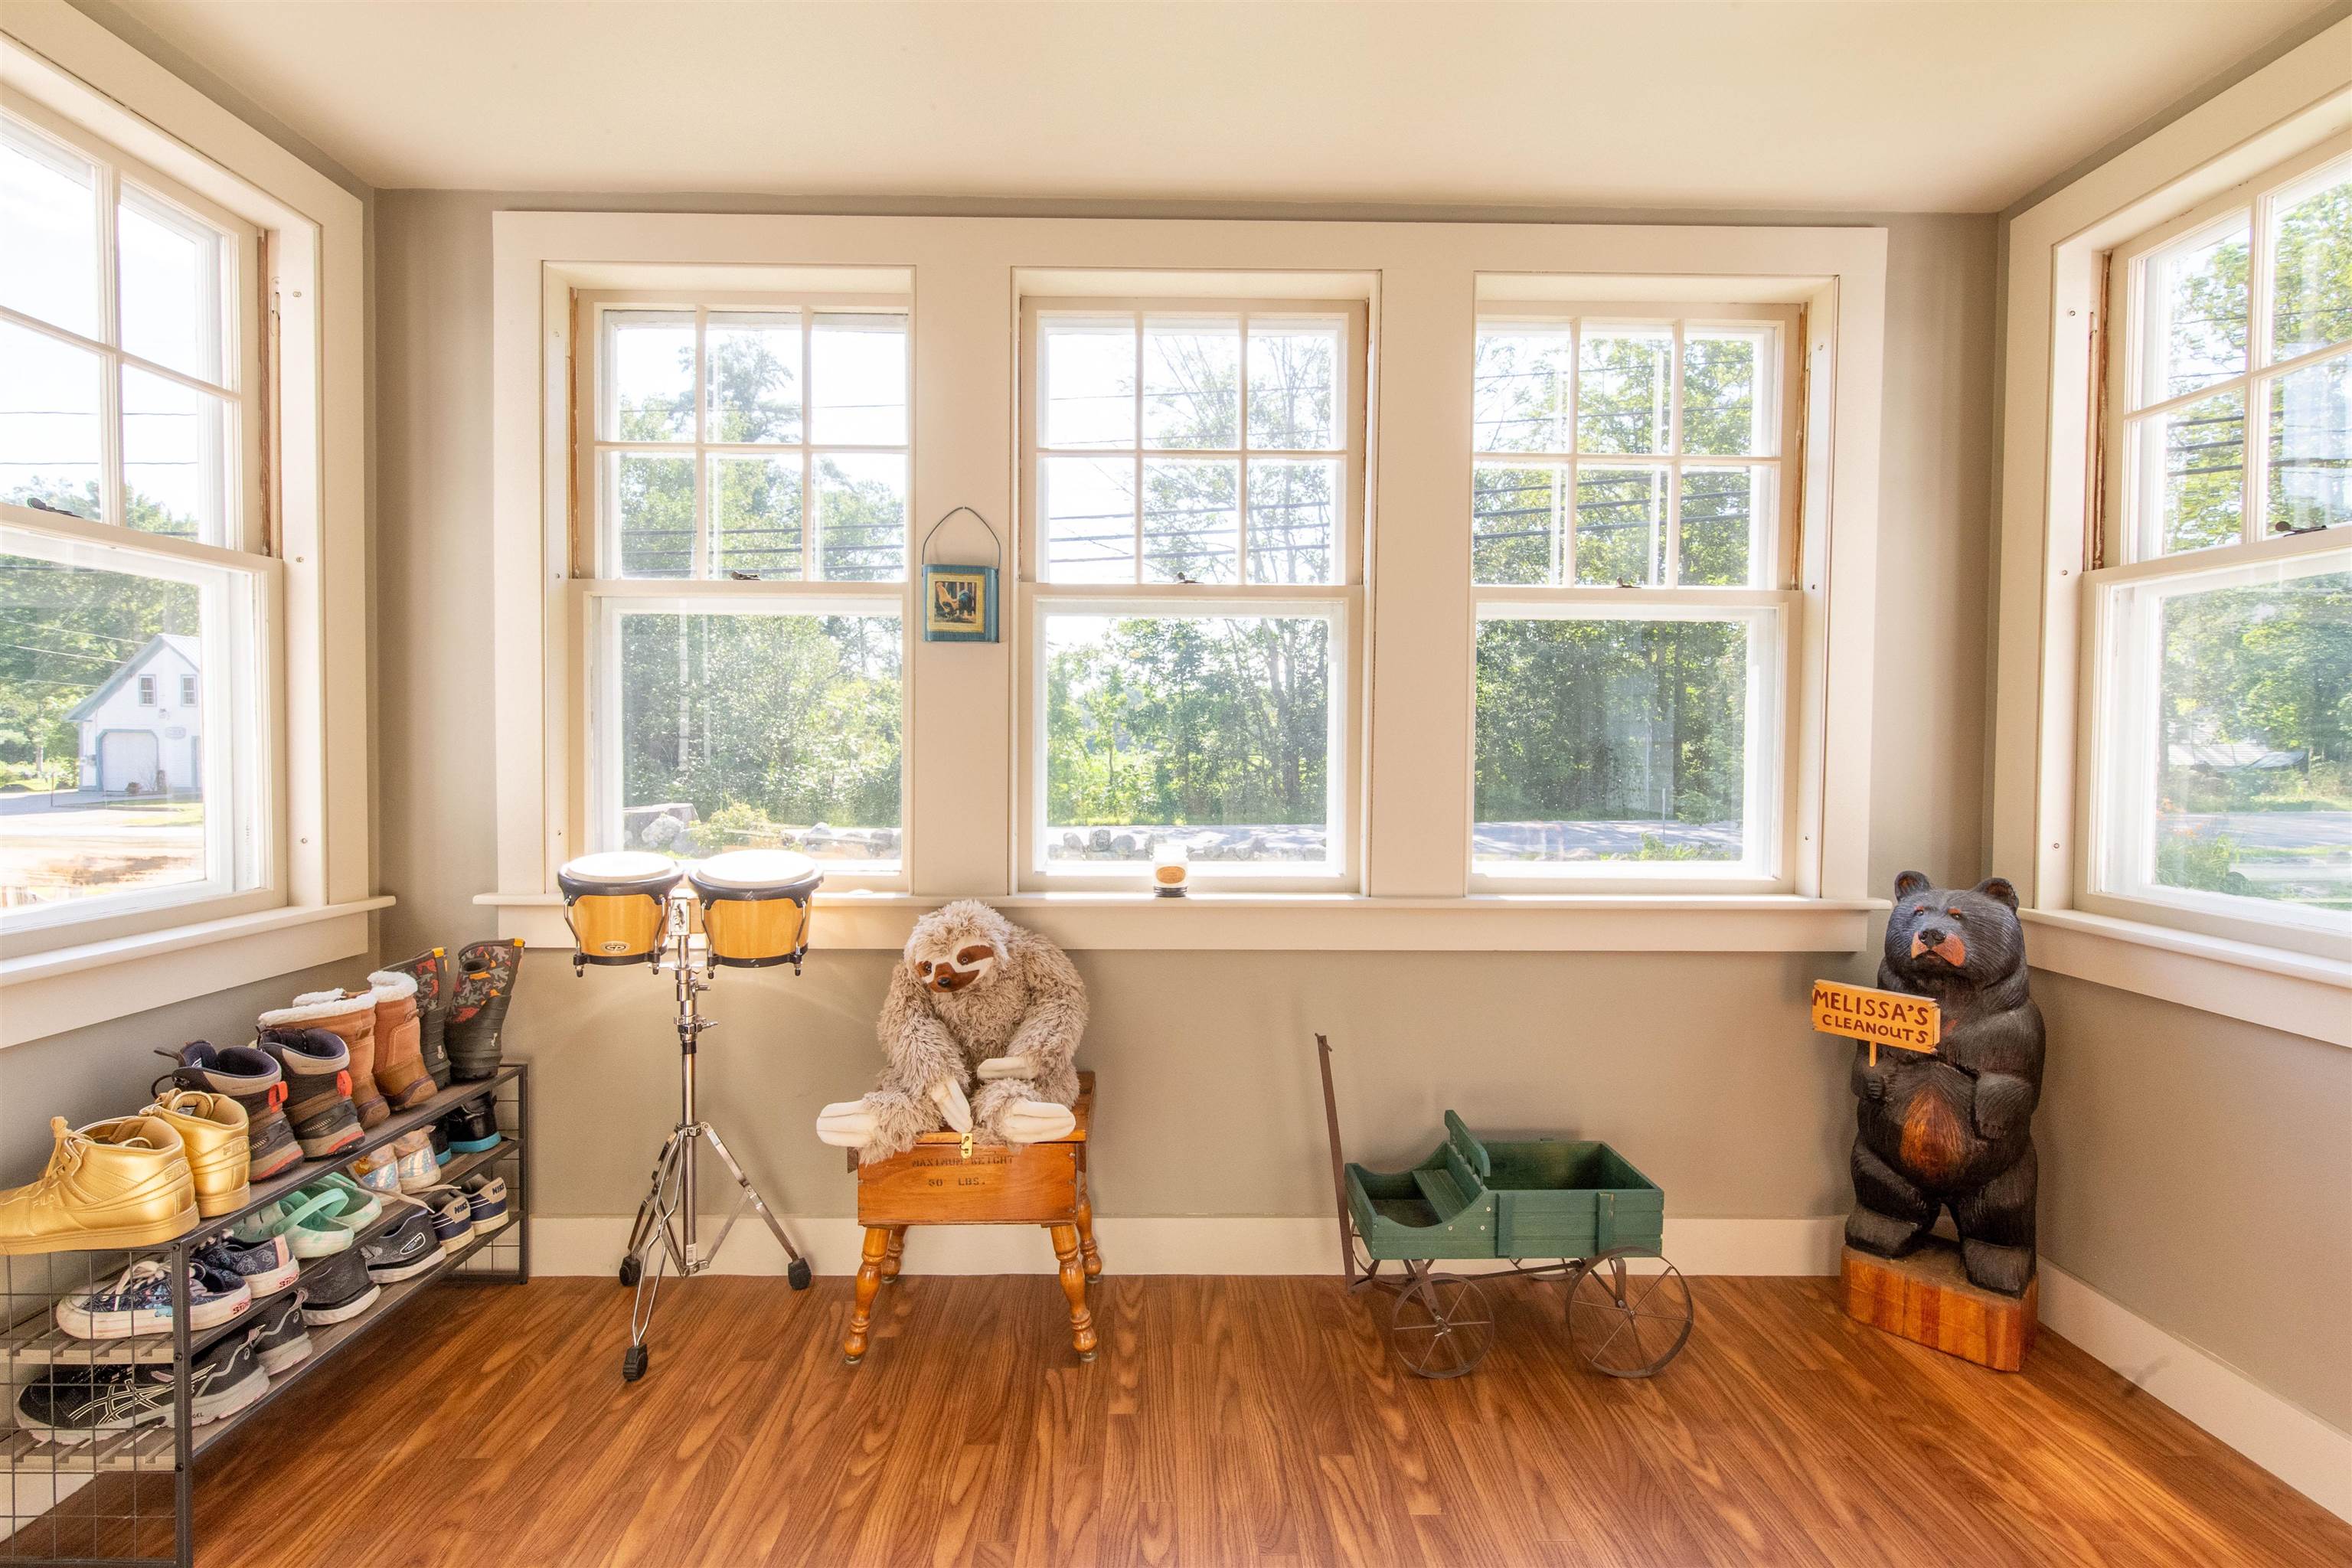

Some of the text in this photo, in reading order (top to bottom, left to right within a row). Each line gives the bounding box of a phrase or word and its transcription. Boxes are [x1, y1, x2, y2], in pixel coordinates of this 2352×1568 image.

[1813, 990, 1929, 1025] MELISSA'S
[1822, 1014, 1929, 1044] CLEANOUTS
[970, 1155, 1014, 1165] WEIGHT
[958, 1178, 985, 1186] LBS.
[492, 1183, 505, 1195] NIKE
[454, 1201, 469, 1214] NIKE
